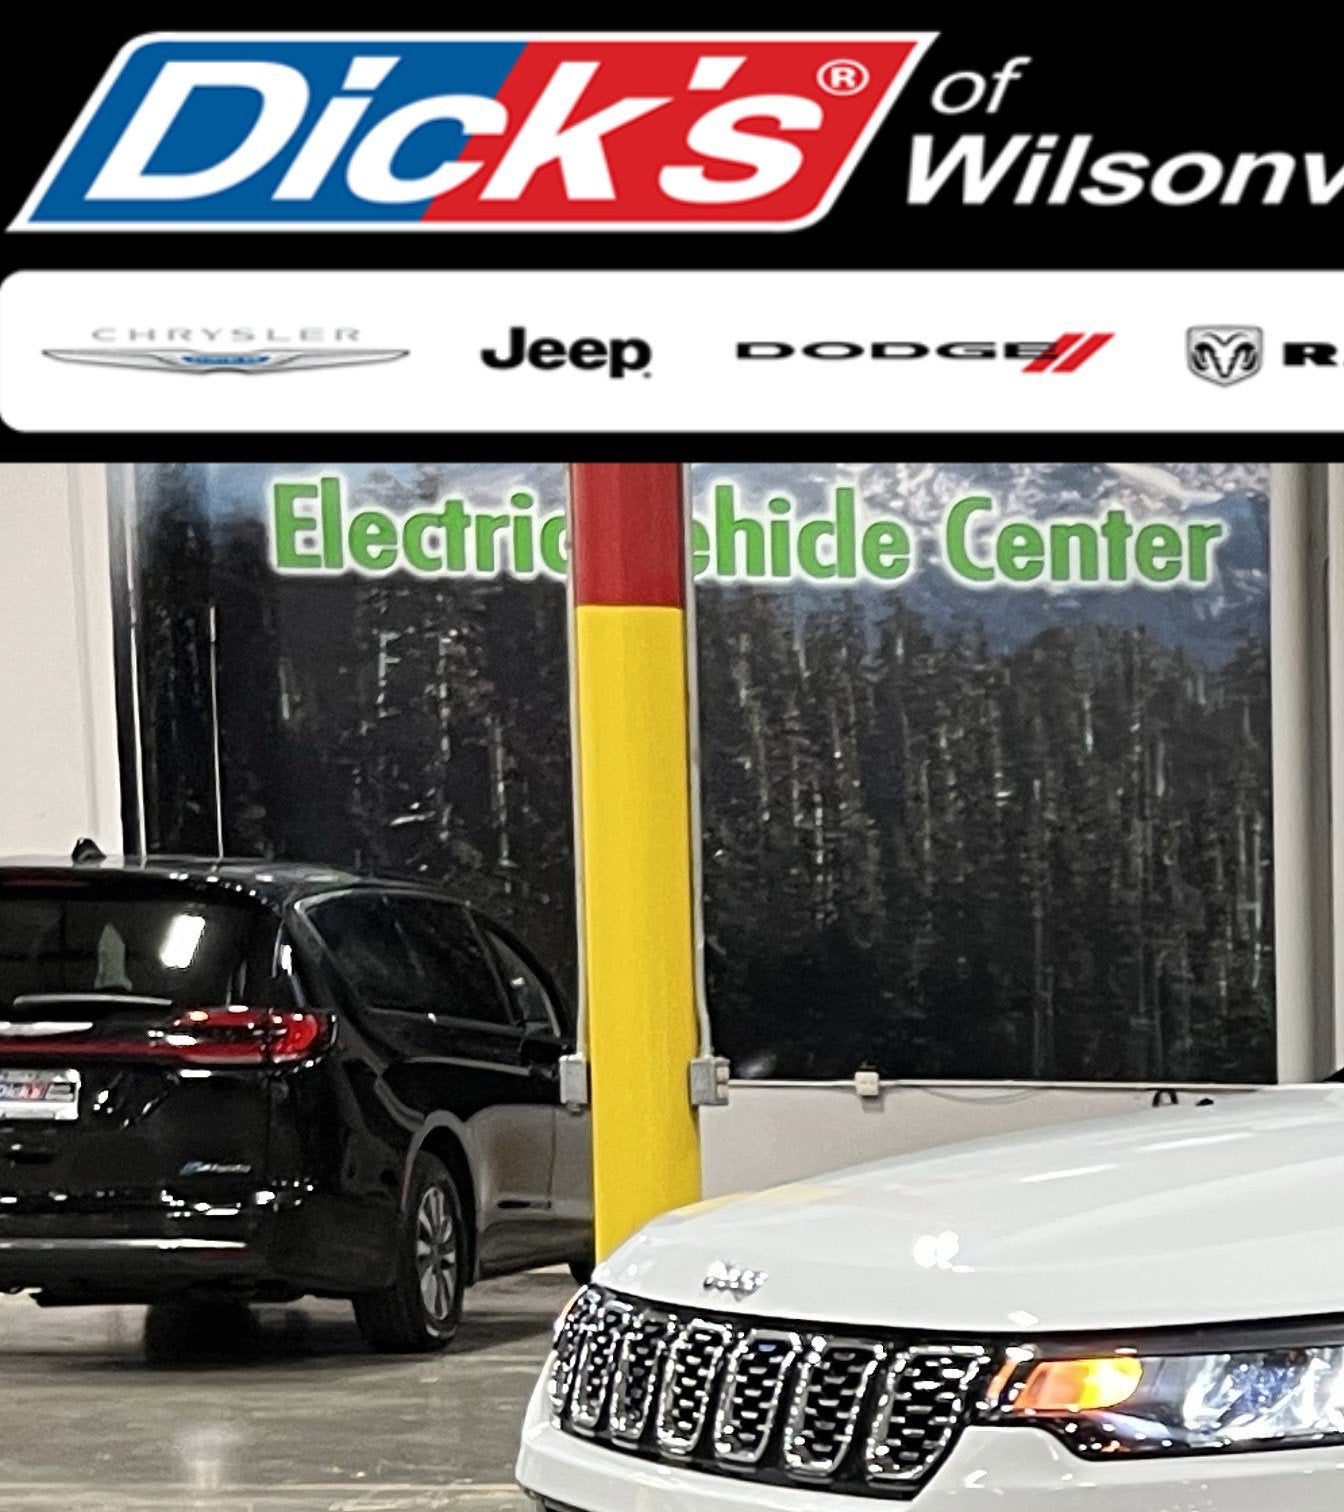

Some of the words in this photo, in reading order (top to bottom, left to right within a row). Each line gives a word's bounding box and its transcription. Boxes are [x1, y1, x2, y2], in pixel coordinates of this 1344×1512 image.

[273, 477, 567, 574] Electric
[693, 485, 910, 579] hicle
[945, 496, 1222, 581] Center
